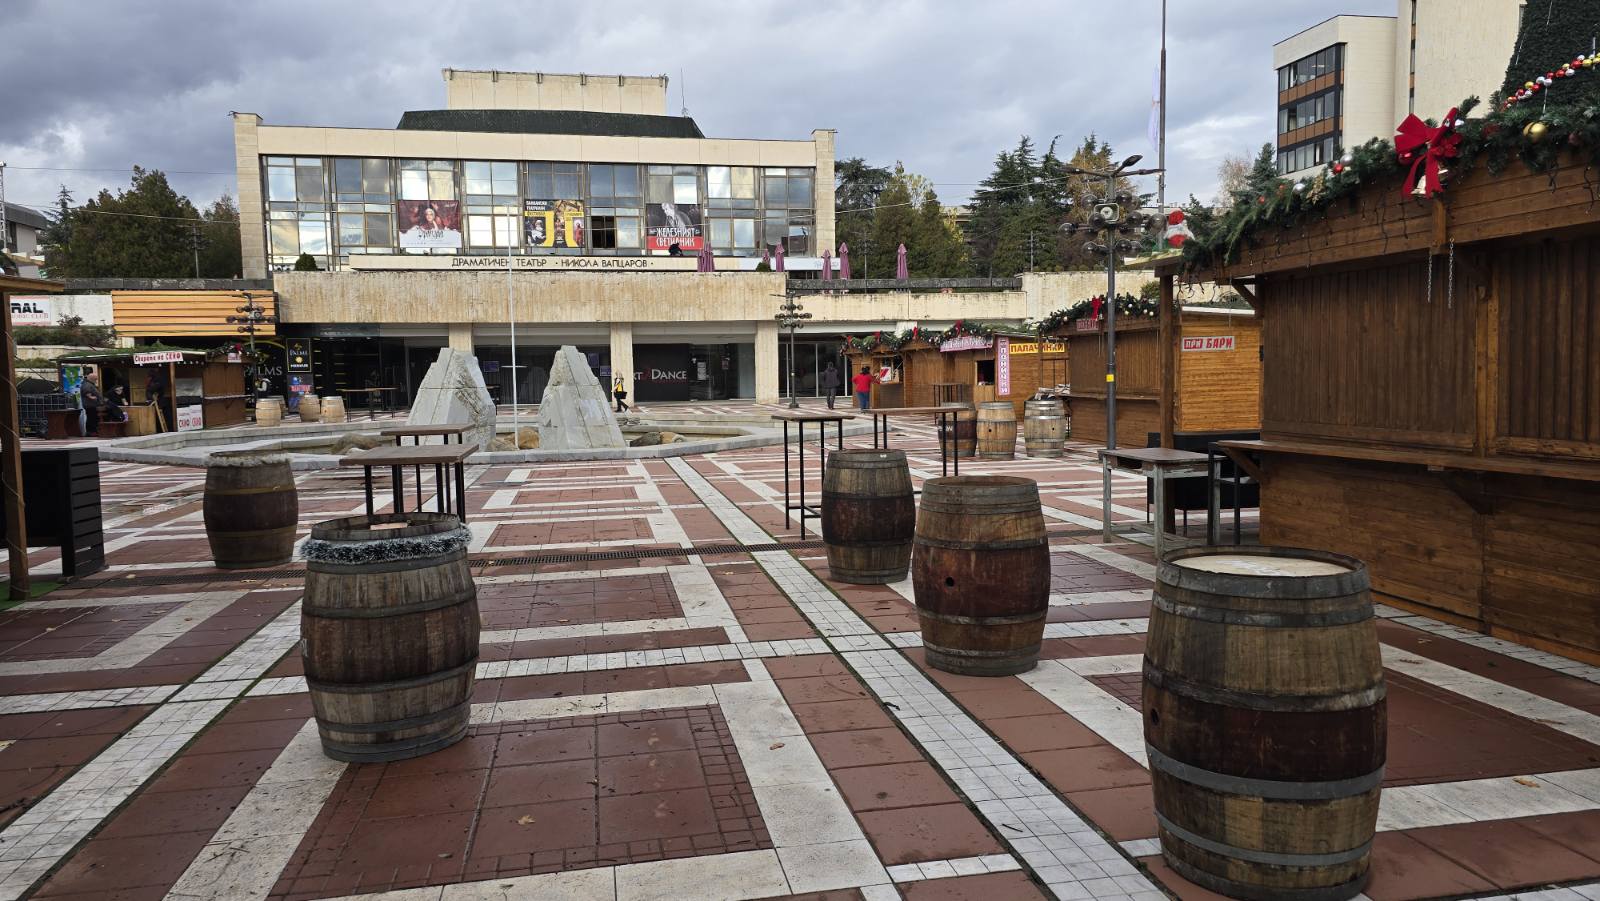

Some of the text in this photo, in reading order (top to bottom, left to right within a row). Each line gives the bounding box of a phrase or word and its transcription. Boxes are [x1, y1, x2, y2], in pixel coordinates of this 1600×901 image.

[656, 227, 695, 237] ЖЕЛЕЗНИЯТ
[451, 258, 648, 269] ДРАМАТИЧЕН ТЕАТЪР НИКОЛА ВАПЦАРОВ
[1010, 343, 1064, 353] ПАЛАЧИНКИ
[1183, 337, 1233, 349] ПРИ БАРИ
[651, 368, 687, 380] DANCE
